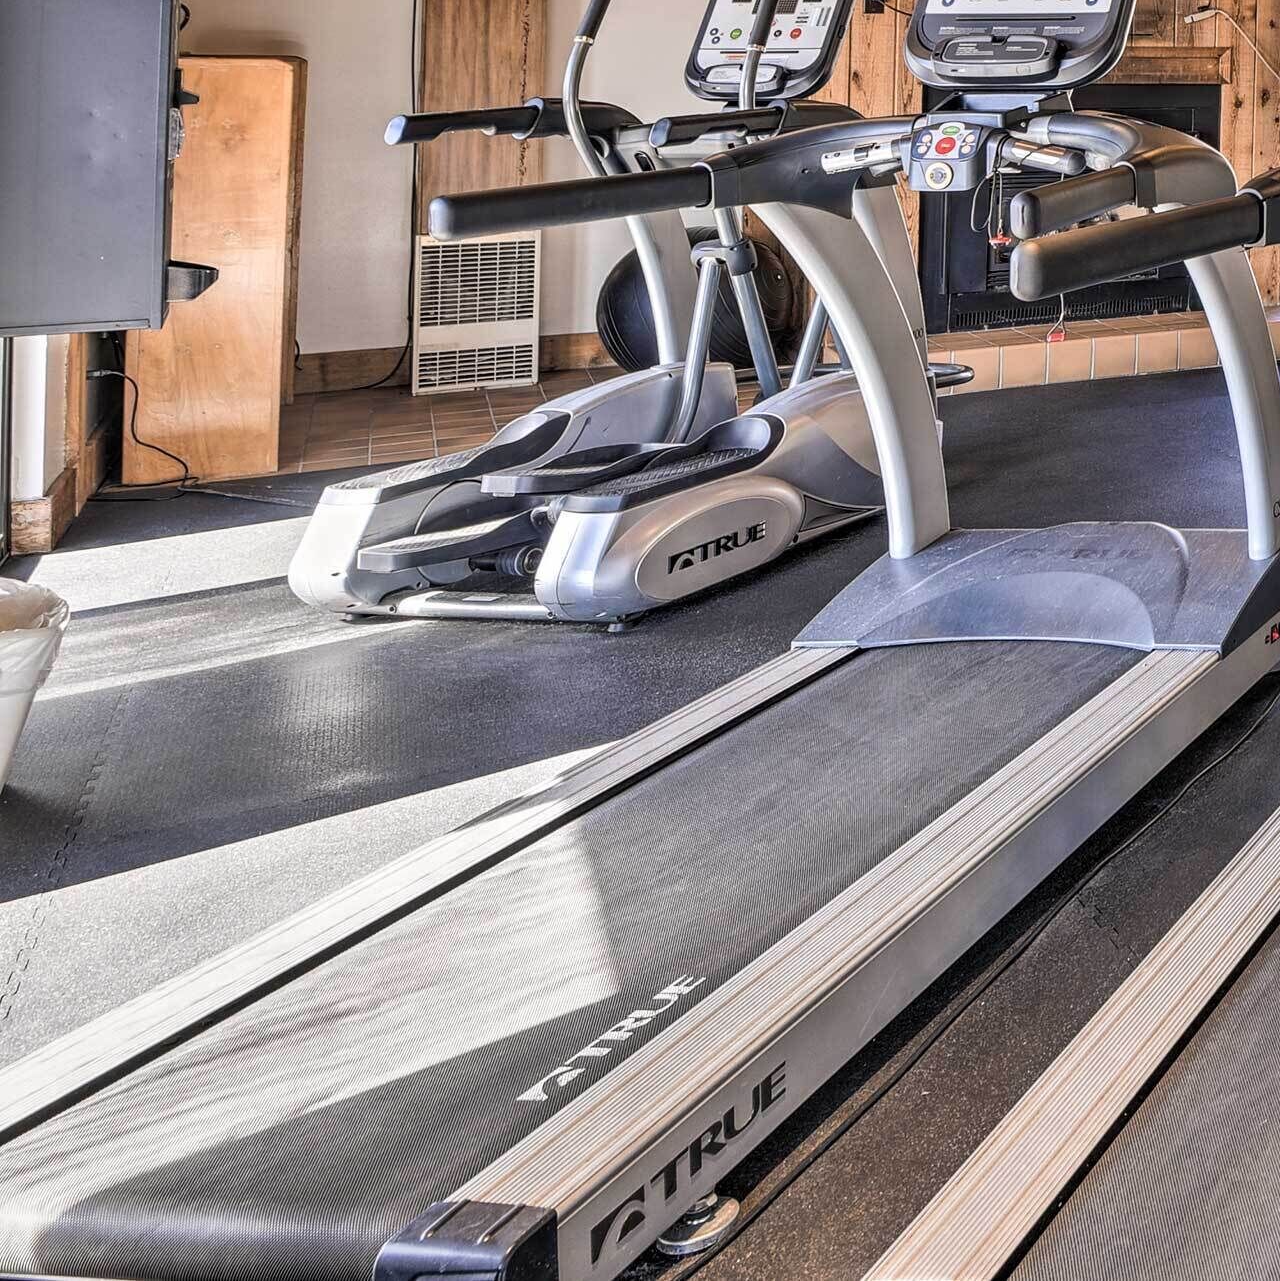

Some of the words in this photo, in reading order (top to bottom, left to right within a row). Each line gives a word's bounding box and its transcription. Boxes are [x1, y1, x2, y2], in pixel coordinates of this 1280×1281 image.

[698, 519, 767, 562] TRUE
[564, 974, 707, 1065] TRUE
[650, 1060, 787, 1200] TRUE
